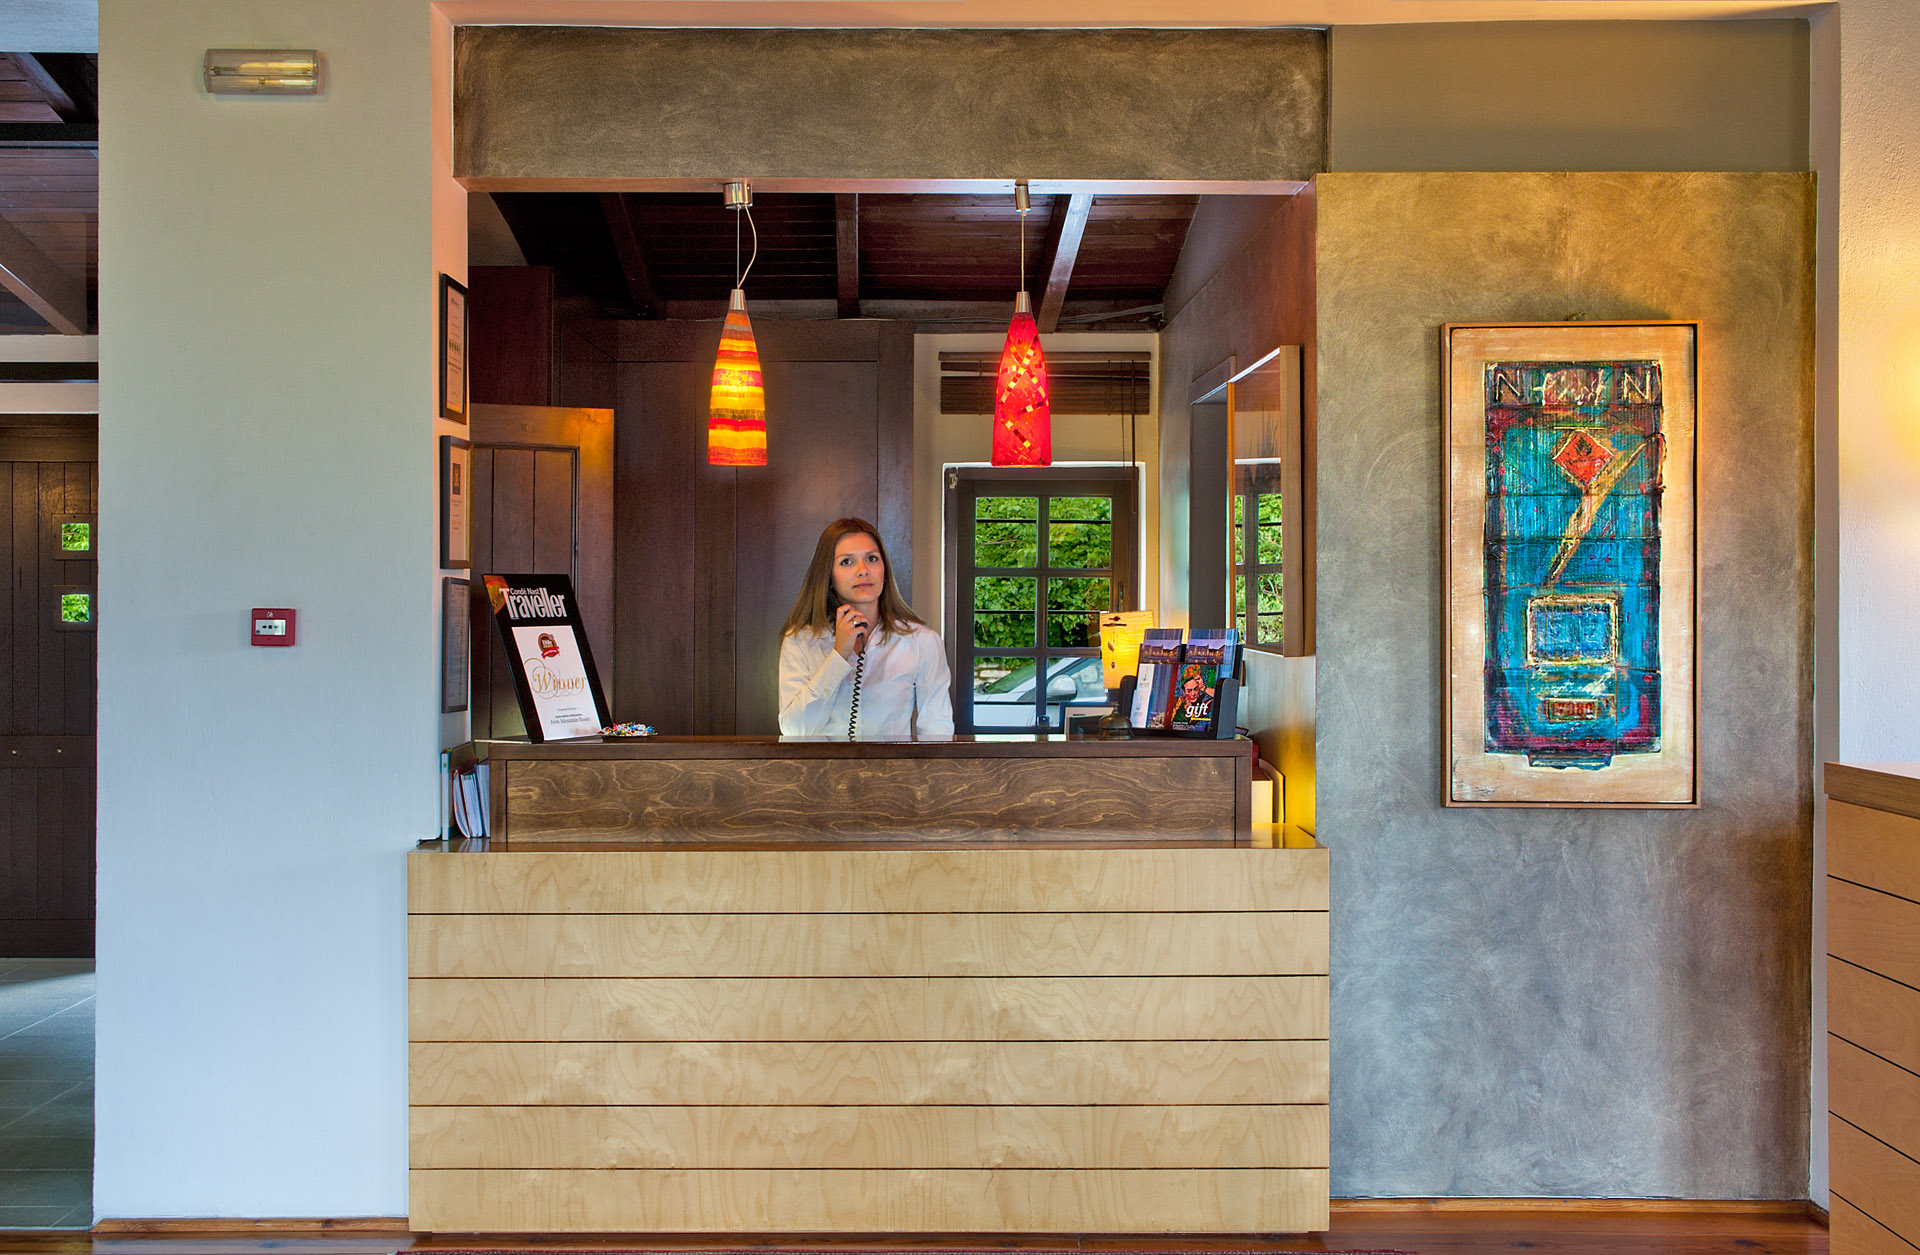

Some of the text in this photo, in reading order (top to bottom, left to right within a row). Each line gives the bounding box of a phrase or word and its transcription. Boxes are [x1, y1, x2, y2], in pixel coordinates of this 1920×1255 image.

[499, 587, 568, 618] Traveller
[530, 665, 587, 696] Winner
[1185, 702, 1209, 718] gift
